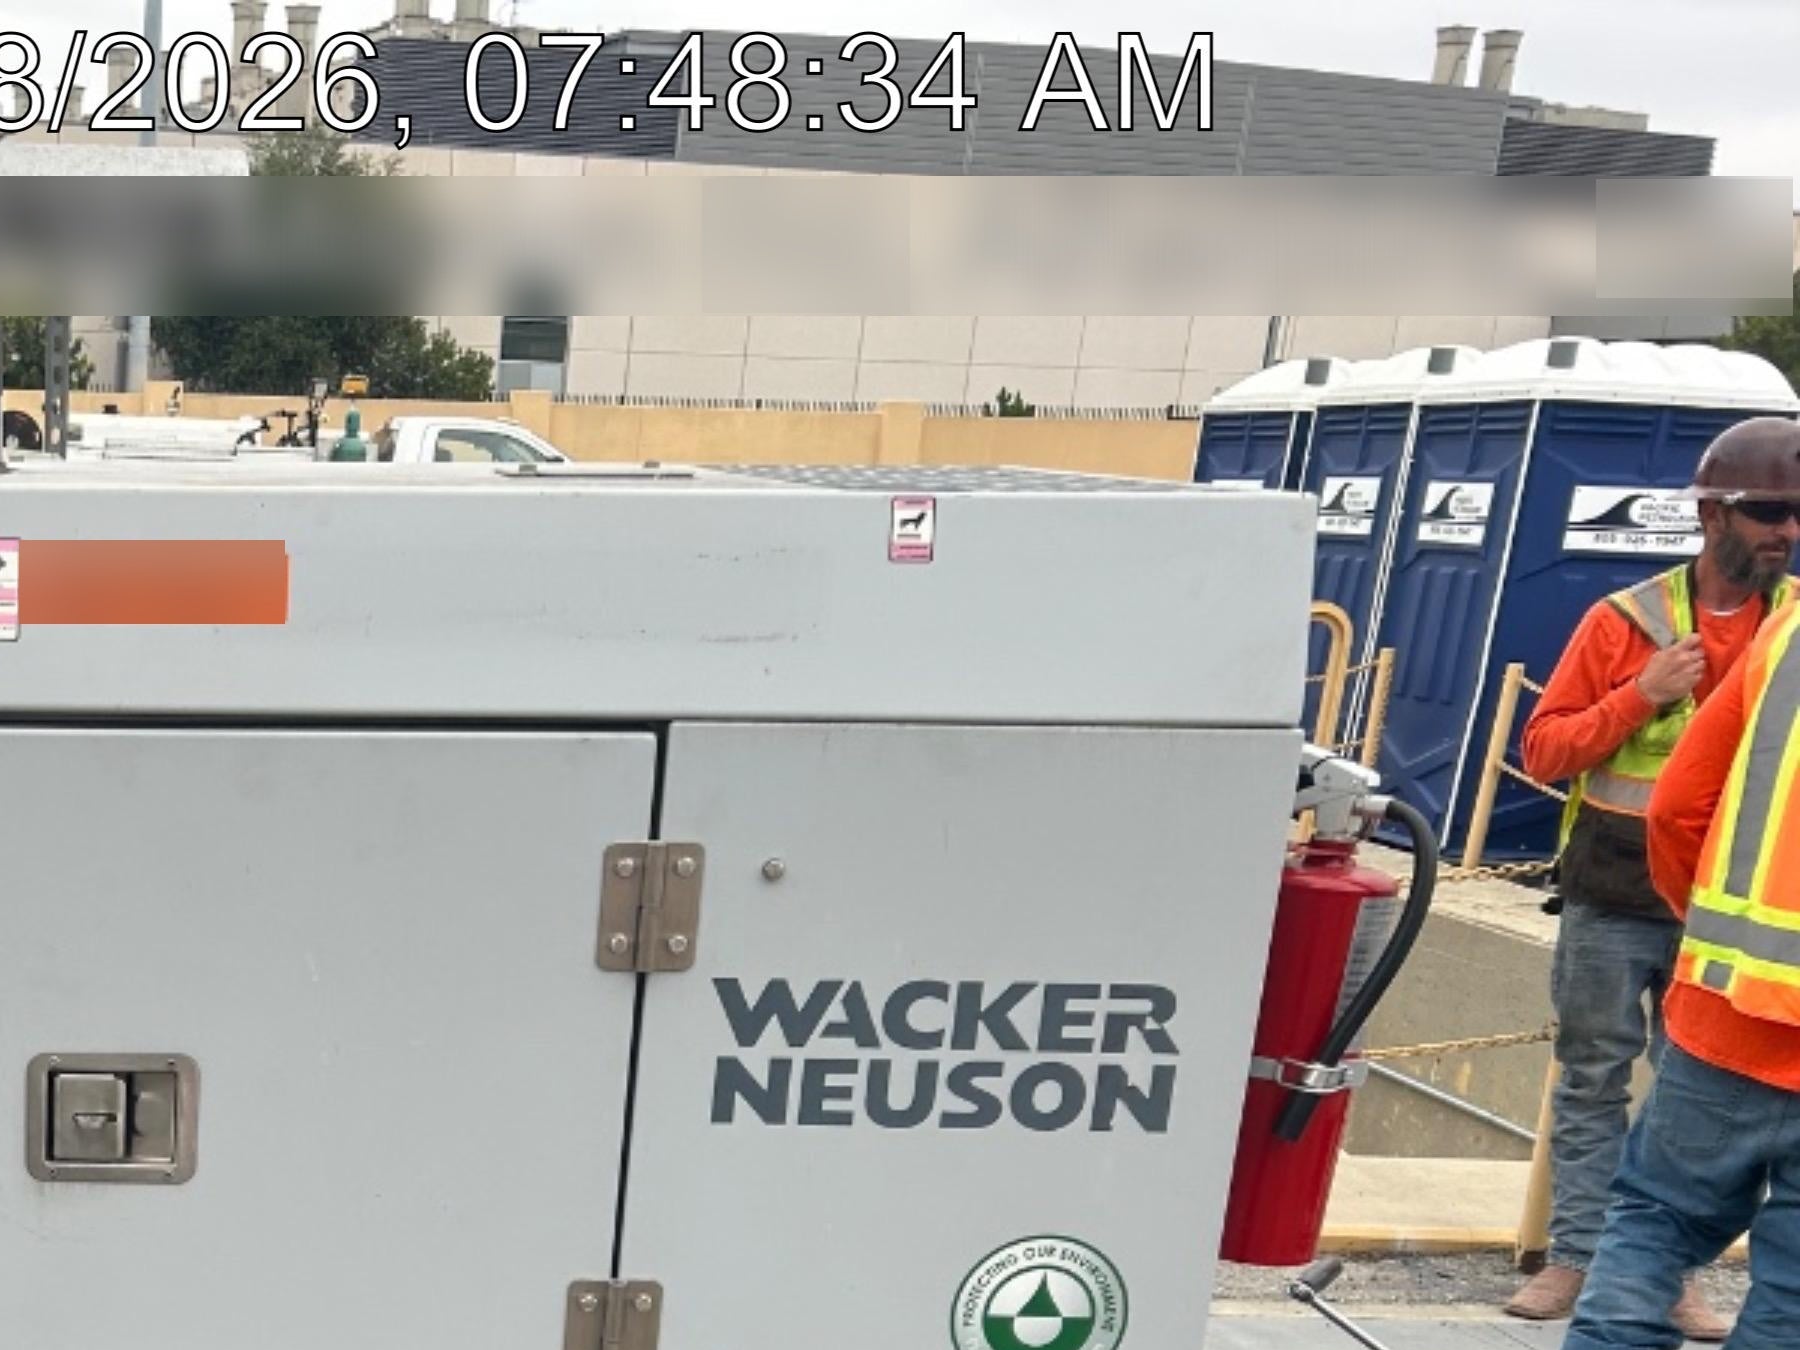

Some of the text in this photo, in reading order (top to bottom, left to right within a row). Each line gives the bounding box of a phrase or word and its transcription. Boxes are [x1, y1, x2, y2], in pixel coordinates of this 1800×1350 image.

[711, 976, 1181, 1055] WACKER
[710, 1056, 1178, 1133] NEUSON
[962, 1246, 1118, 1333] PROTECTING OUR ENVIRONMENT
